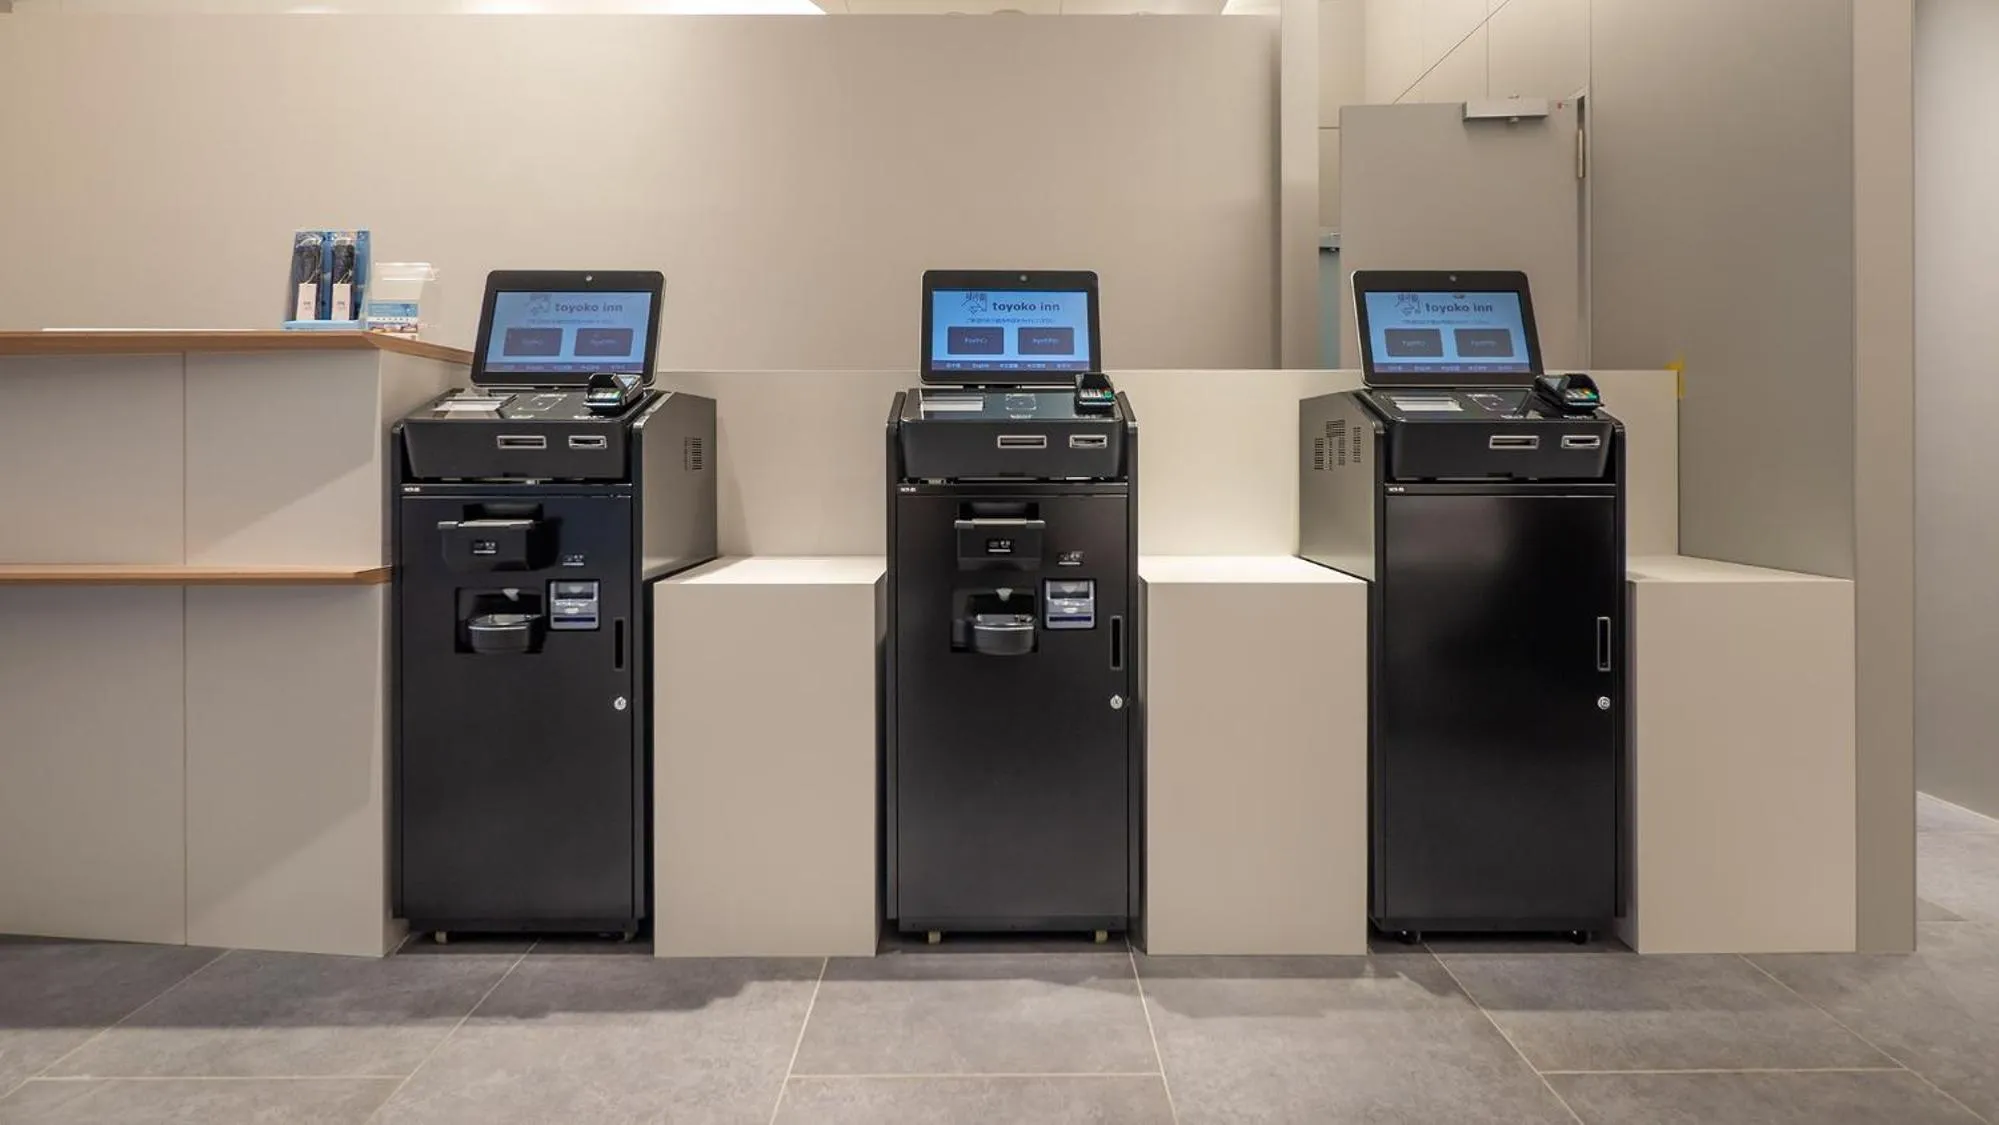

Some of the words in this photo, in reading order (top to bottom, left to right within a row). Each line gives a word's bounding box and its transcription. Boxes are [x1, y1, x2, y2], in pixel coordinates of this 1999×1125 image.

[555, 300, 599, 313] toyoko
[603, 301, 624, 312] inn
[992, 302, 1037, 313] toyoko
[1040, 302, 1060, 311] inn
[1425, 302, 1470, 314] toyoko
[1473, 303, 1493, 312] inn
